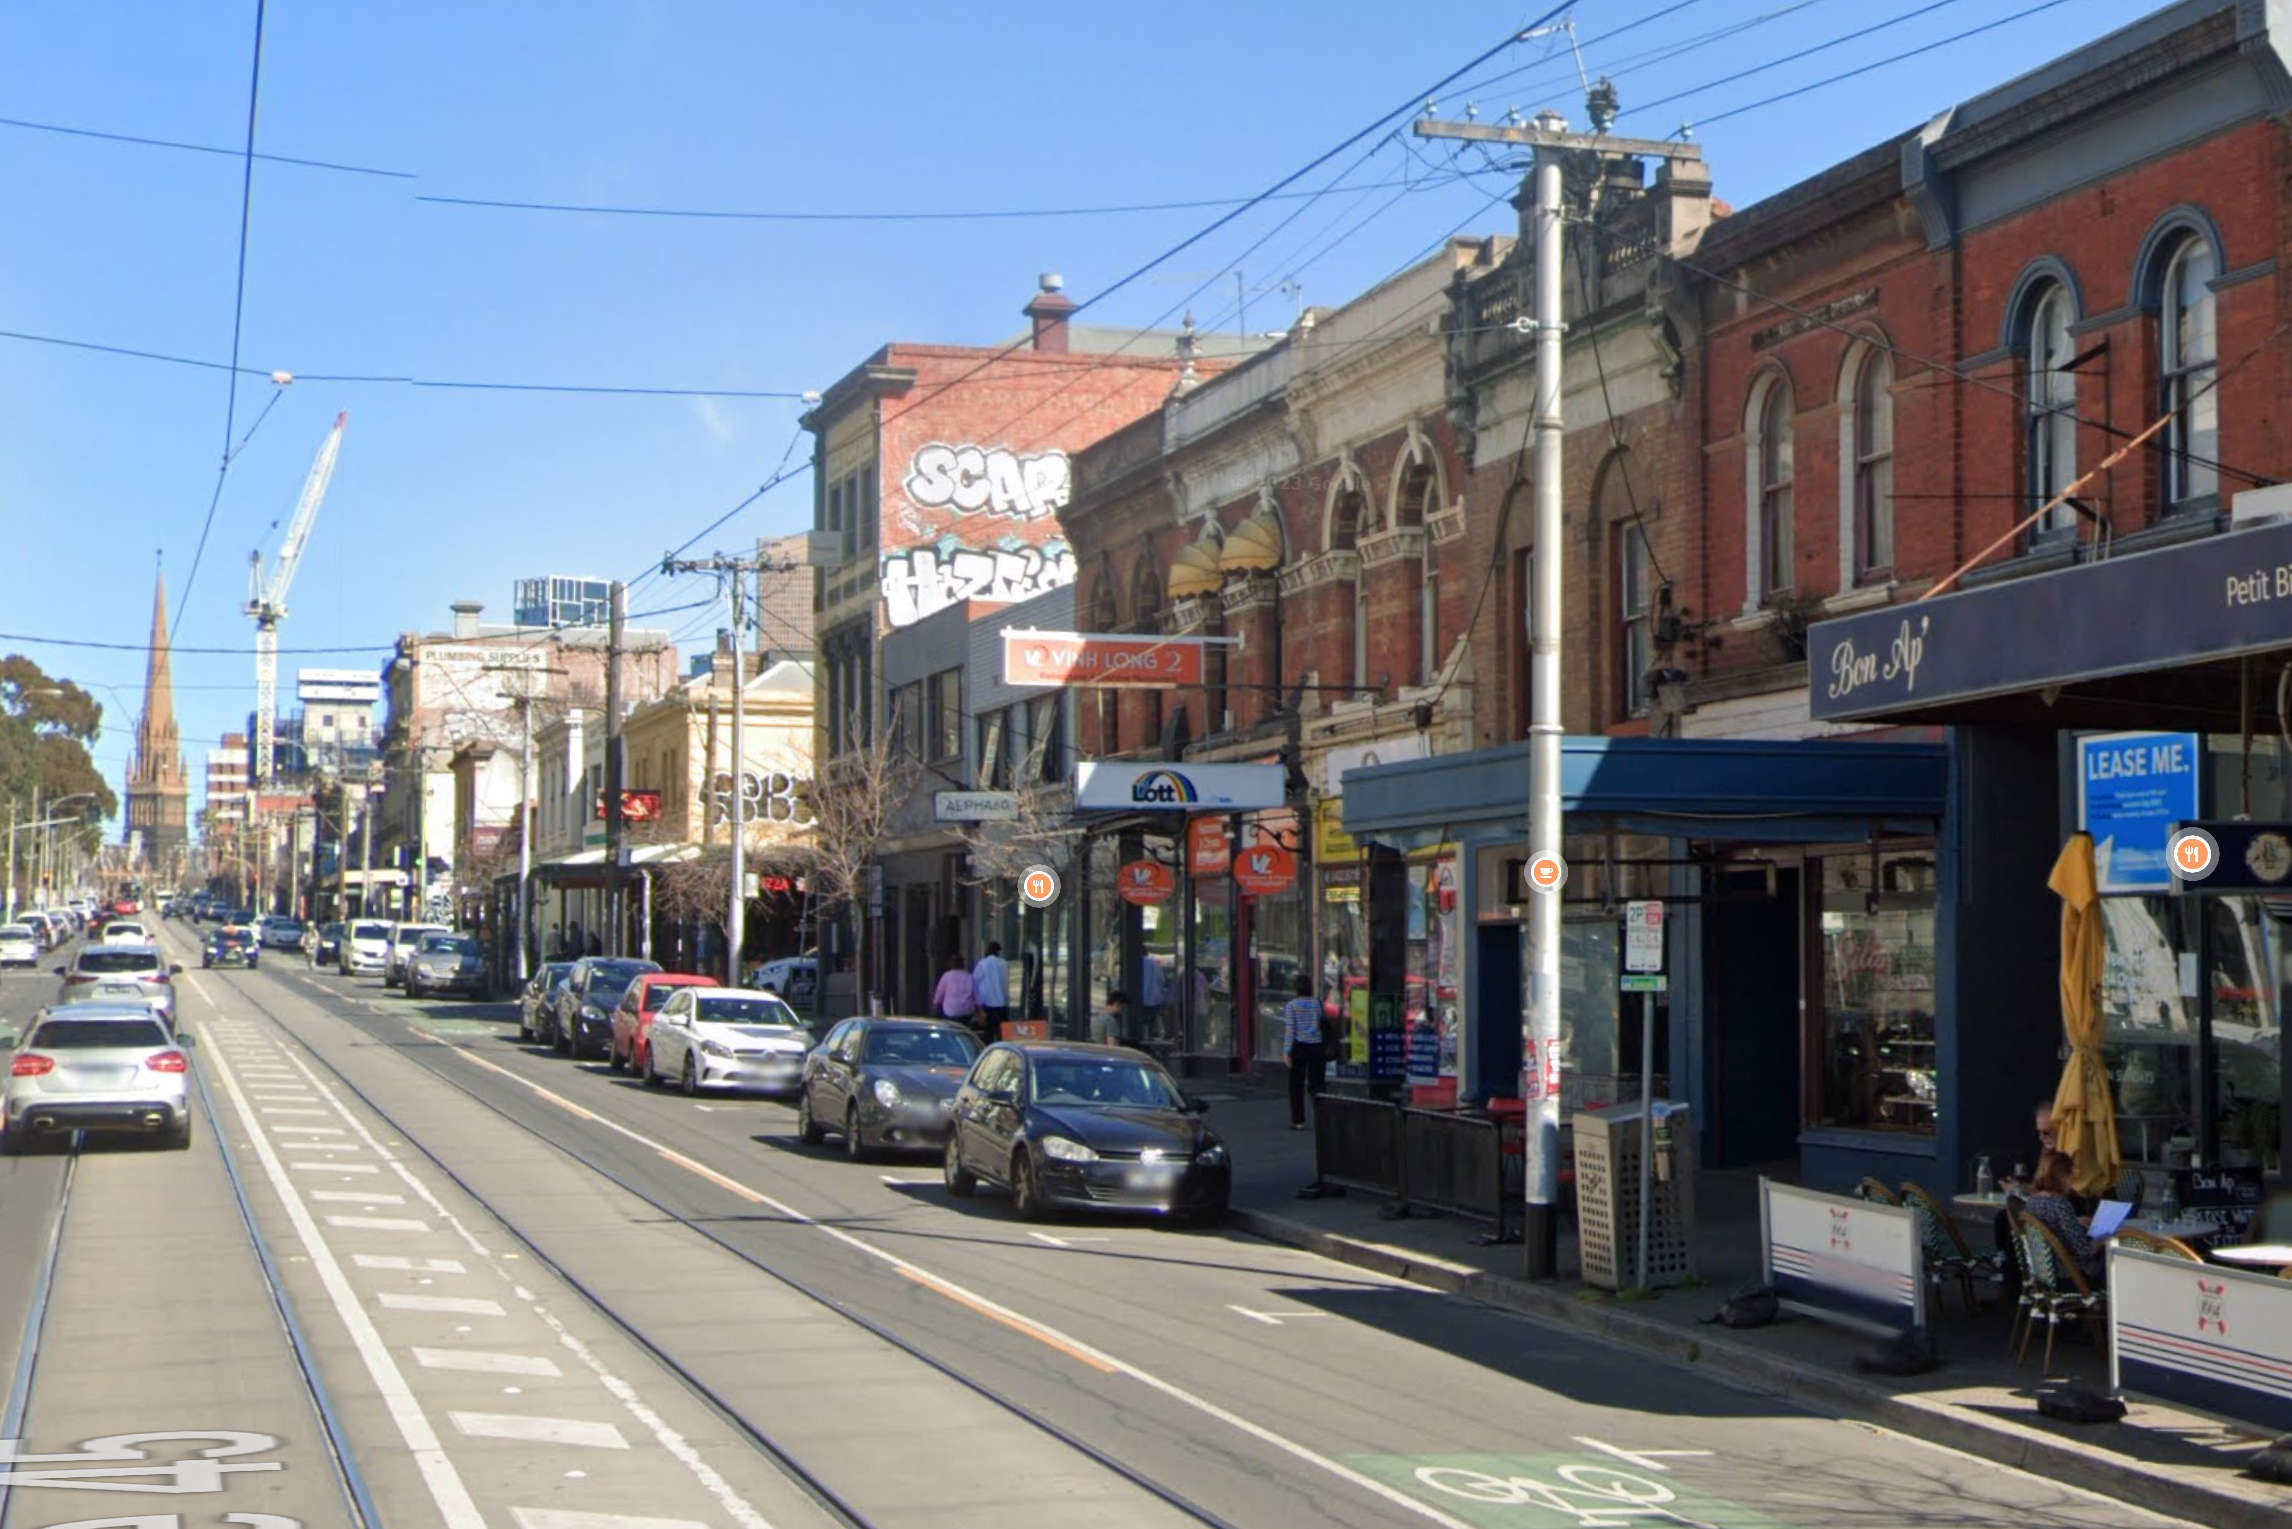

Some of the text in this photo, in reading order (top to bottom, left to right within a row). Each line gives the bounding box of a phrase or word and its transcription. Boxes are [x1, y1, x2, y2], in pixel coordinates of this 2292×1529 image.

[2226, 569, 2271, 608] Petit
[425, 650, 540, 664] PLUMBING SUPPLIES
[1052, 650, 1181, 672] VINH LONG 2
[1828, 639, 1878, 700] Bon
[2088, 744, 2190, 780] LEASE ME.
[1132, 784, 1176, 802] Lott
